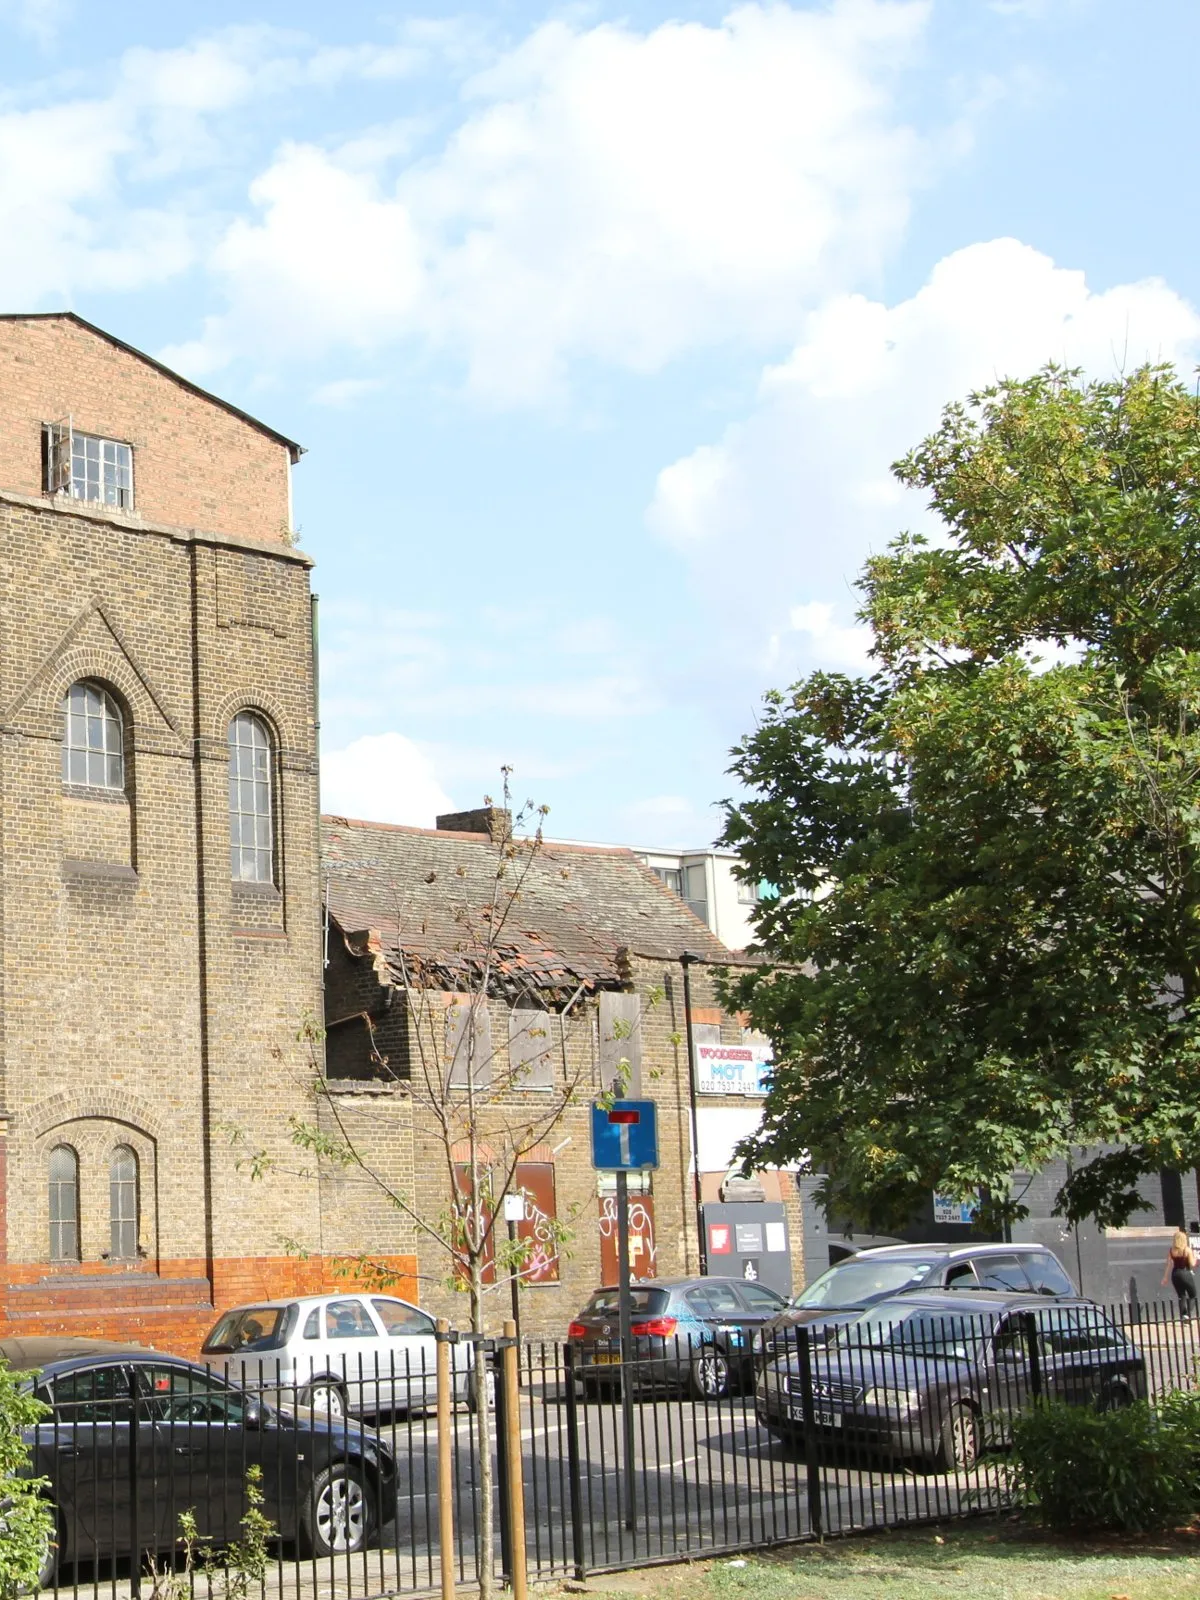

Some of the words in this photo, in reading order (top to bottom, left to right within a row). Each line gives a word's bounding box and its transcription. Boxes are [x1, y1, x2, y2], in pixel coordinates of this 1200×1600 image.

[710, 1063, 745, 1081] MOT
[700, 1080, 715, 1091] 020
[717, 1081, 735, 1091] 7537
[737, 1082, 755, 1092] 2447
